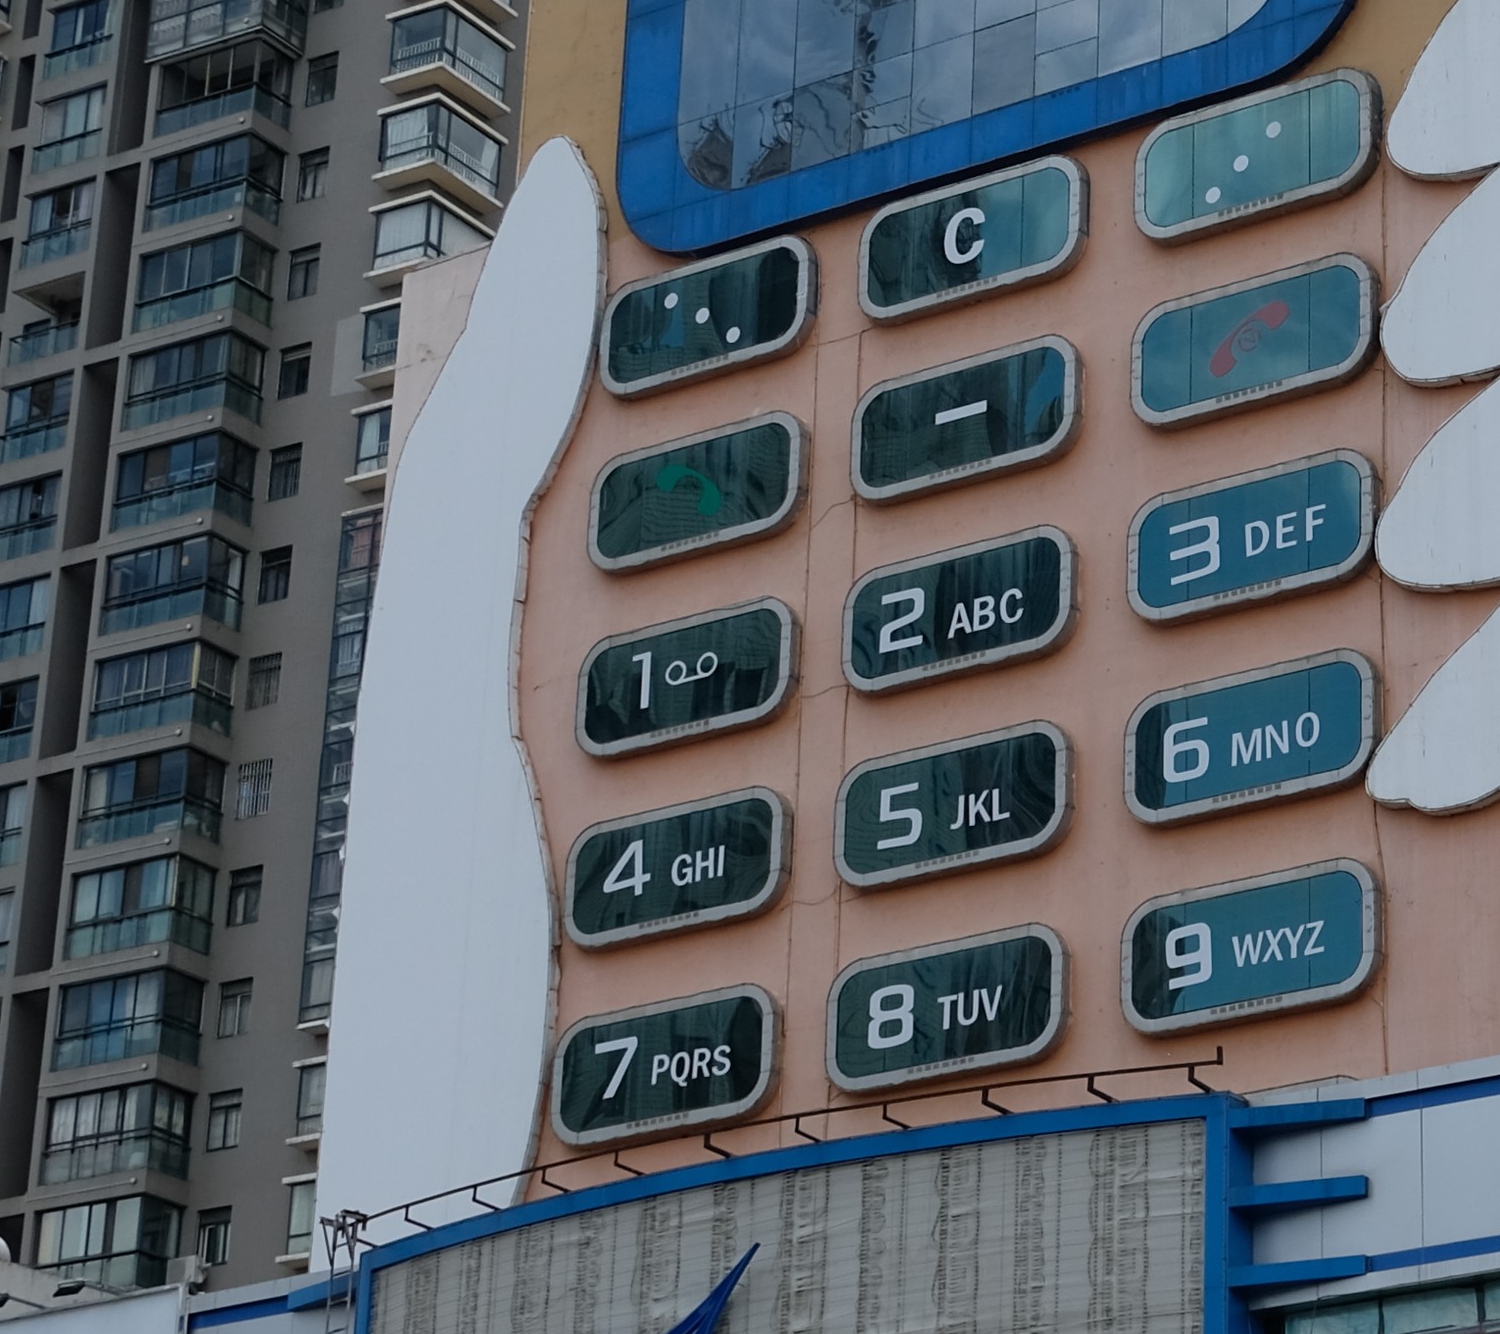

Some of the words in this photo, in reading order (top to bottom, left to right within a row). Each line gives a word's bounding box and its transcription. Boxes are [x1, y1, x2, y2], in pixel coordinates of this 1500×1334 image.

[942, 207, 986, 265] C
[1169, 516, 1221, 586] 3
[1244, 503, 1327, 558] DEF
[878, 587, 926, 655] 2
[947, 588, 1025, 640] ABC
[631, 651, 653, 710] 1
[1162, 716, 1210, 784] 6
[1230, 711, 1321, 768] MNO
[877, 782, 924, 850] 5
[949, 788, 1011, 831] JKL
[602, 839, 651, 897] 4
[670, 844, 726, 888] GHI
[1165, 922, 1212, 991] 9
[1231, 919, 1325, 968] WXYZ
[867, 983, 915, 1050] 8
[937, 985, 1003, 1030] TUV
[594, 1036, 639, 1100] 7
[650, 1044, 732, 1087] PQRS
